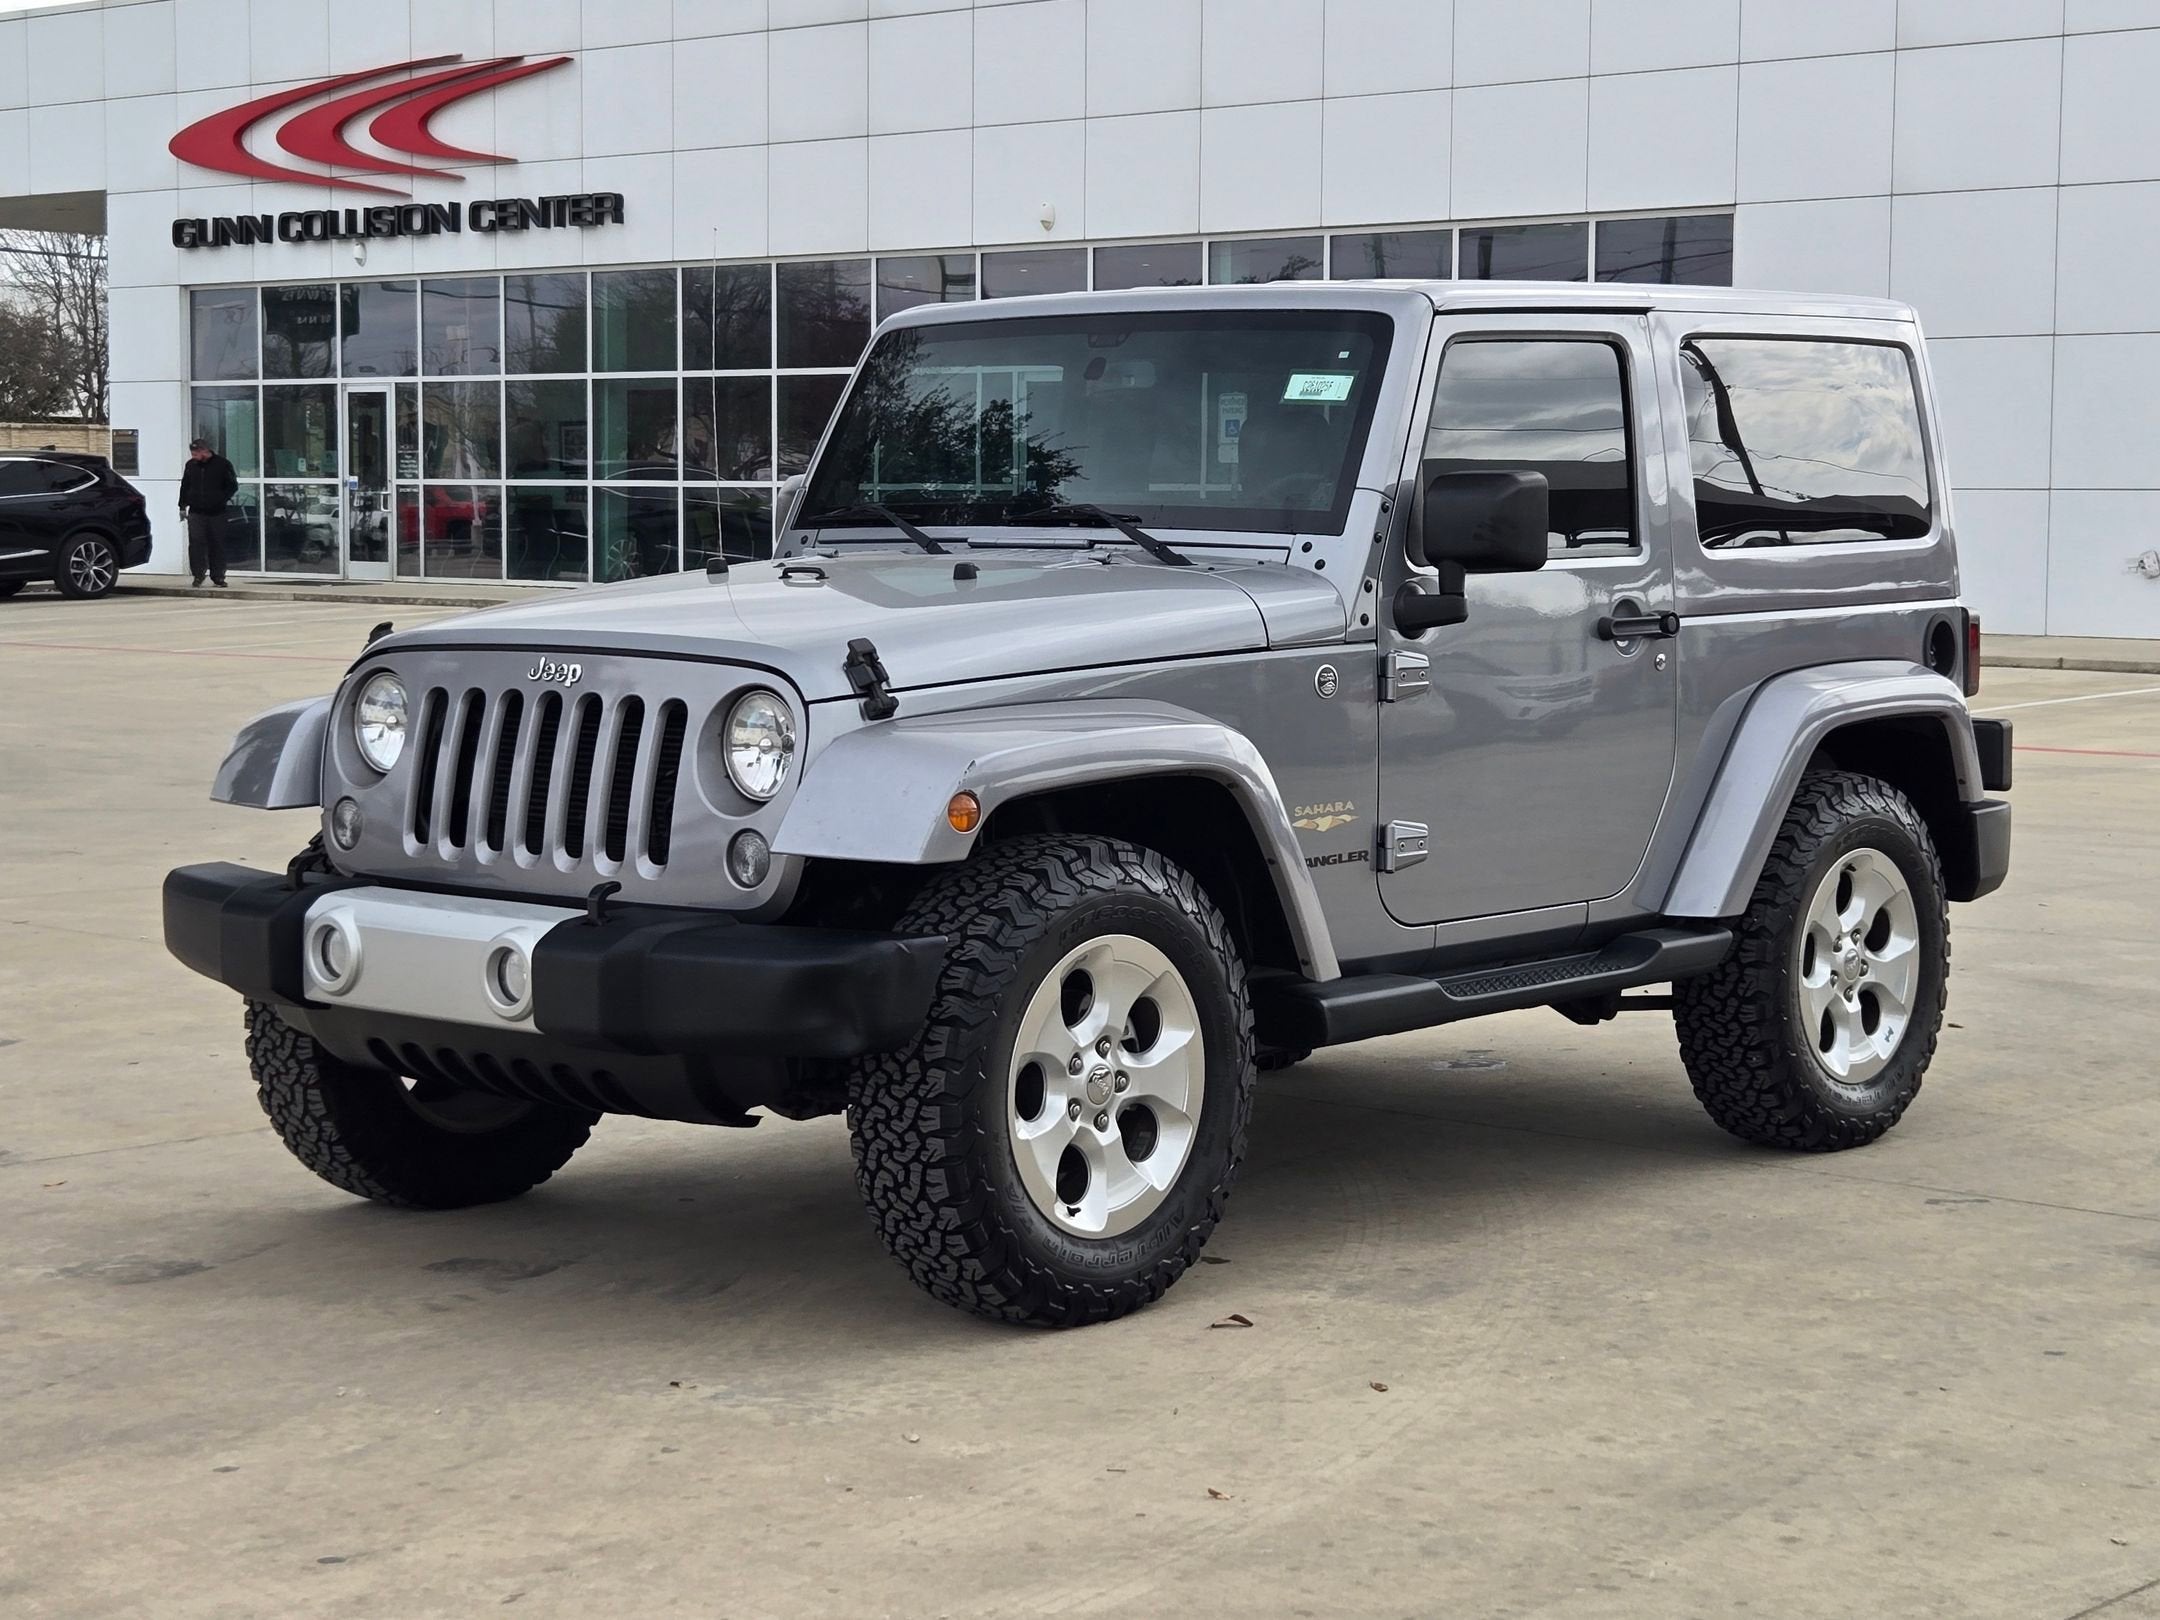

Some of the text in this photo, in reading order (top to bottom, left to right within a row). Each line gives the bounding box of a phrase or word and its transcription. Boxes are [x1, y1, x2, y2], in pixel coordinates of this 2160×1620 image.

[172, 193, 625, 248] GUNN COLLISION CENTER
[528, 655, 582, 687] Jeep
[1294, 800, 1355, 816] SAHARA
[1304, 850, 1369, 868] ANGLER
